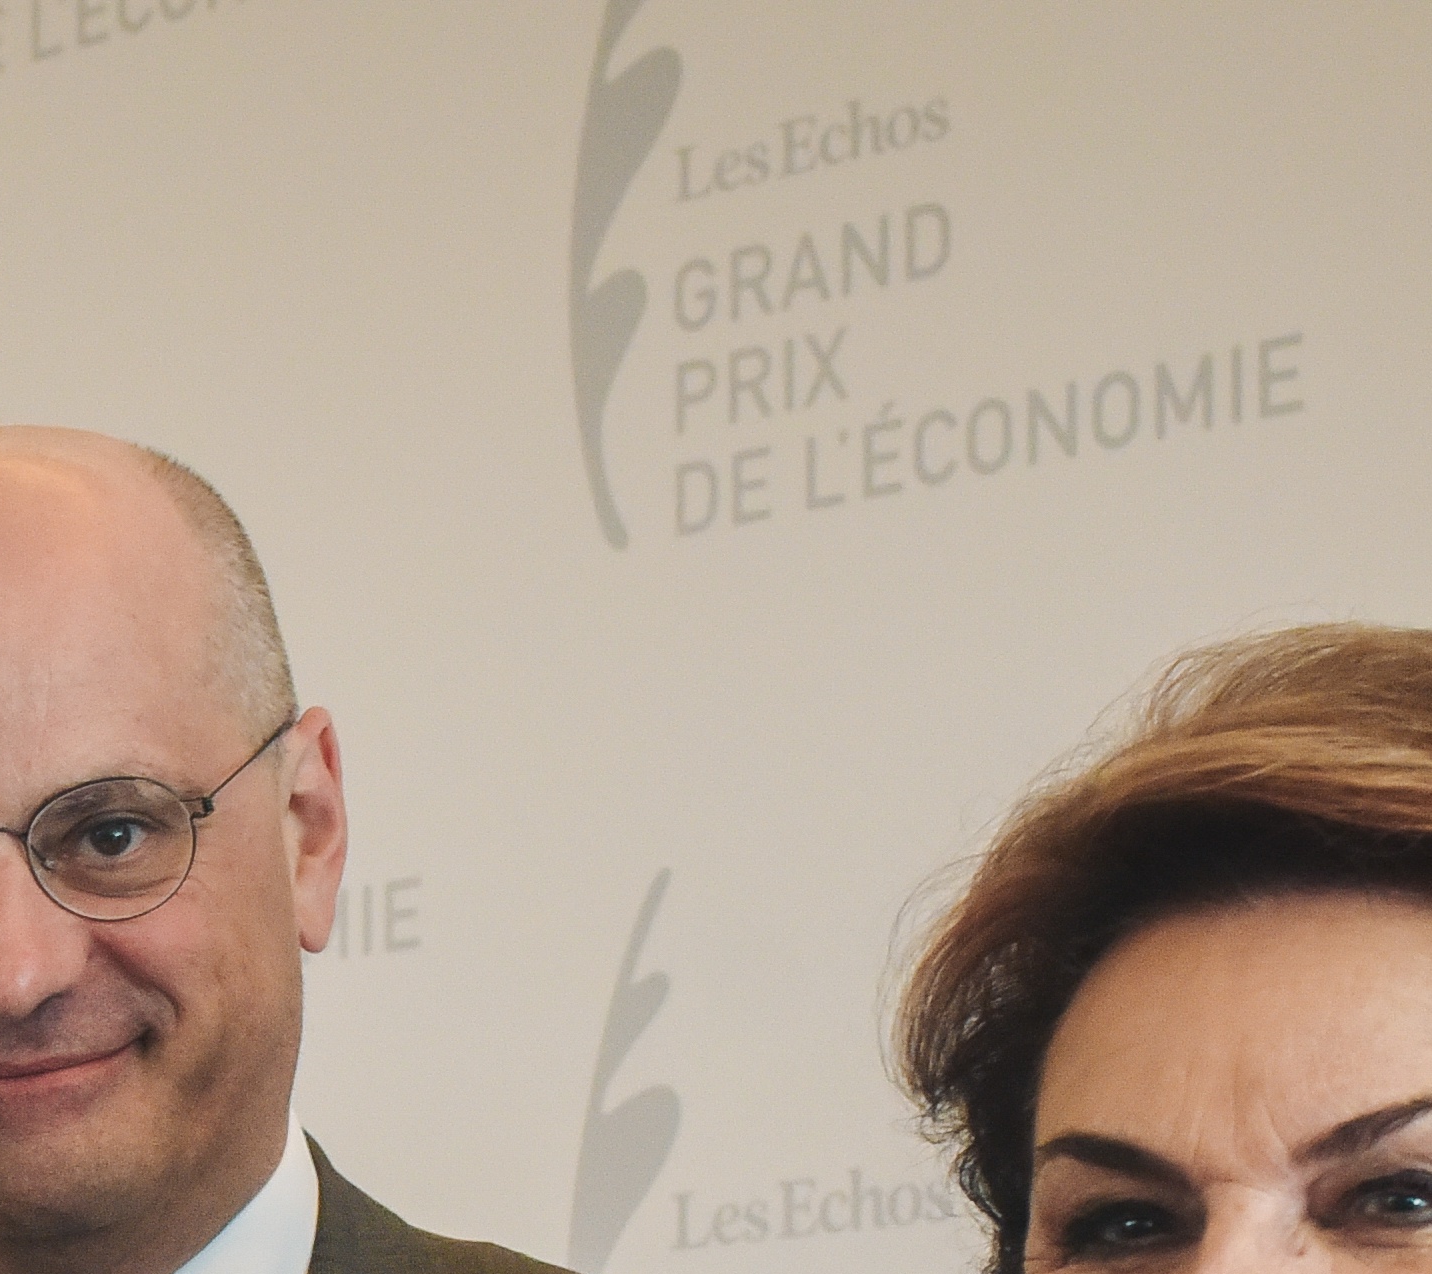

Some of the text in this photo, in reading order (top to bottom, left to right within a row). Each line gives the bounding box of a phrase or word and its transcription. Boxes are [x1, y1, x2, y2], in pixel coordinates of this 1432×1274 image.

[672, 93, 953, 204] Les Echos
[672, 200, 954, 333] GRAND
[673, 325, 851, 438] PRIX
[673, 329, 1308, 538] DE L'ÉCONOMIE
[669, 1188, 771, 1252] Les
